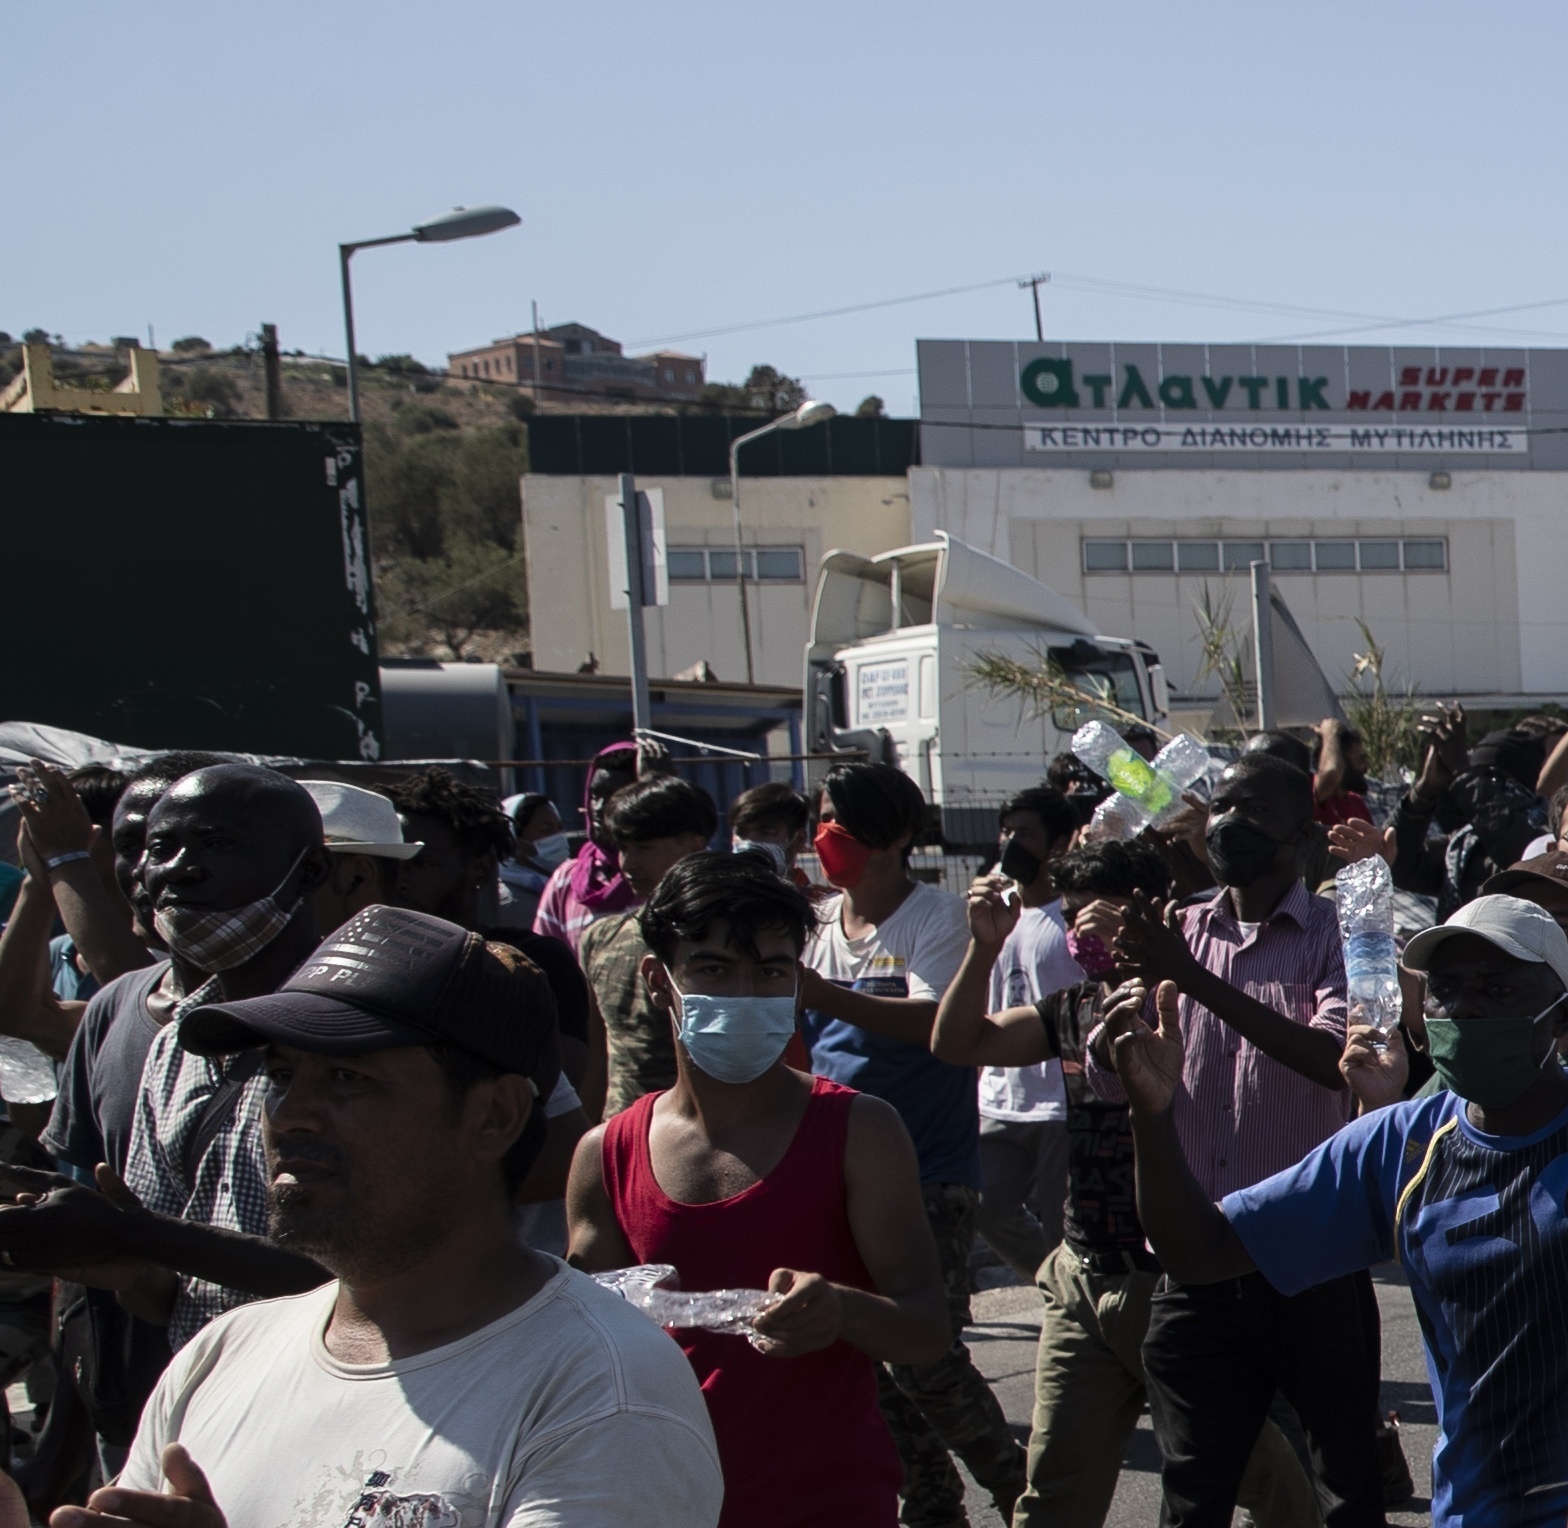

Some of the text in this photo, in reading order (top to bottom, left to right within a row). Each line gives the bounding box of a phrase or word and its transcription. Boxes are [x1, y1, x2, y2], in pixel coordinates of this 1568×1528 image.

[1400, 366, 1526, 388] SUPER
[1346, 390, 1526, 411] MARKETS
[1040, 426, 1513, 450] ΚΕΝΤΡΟ ΔΙΑΝΟΜΗΣ ΜΥΤΙΛΗΝΗΣ
